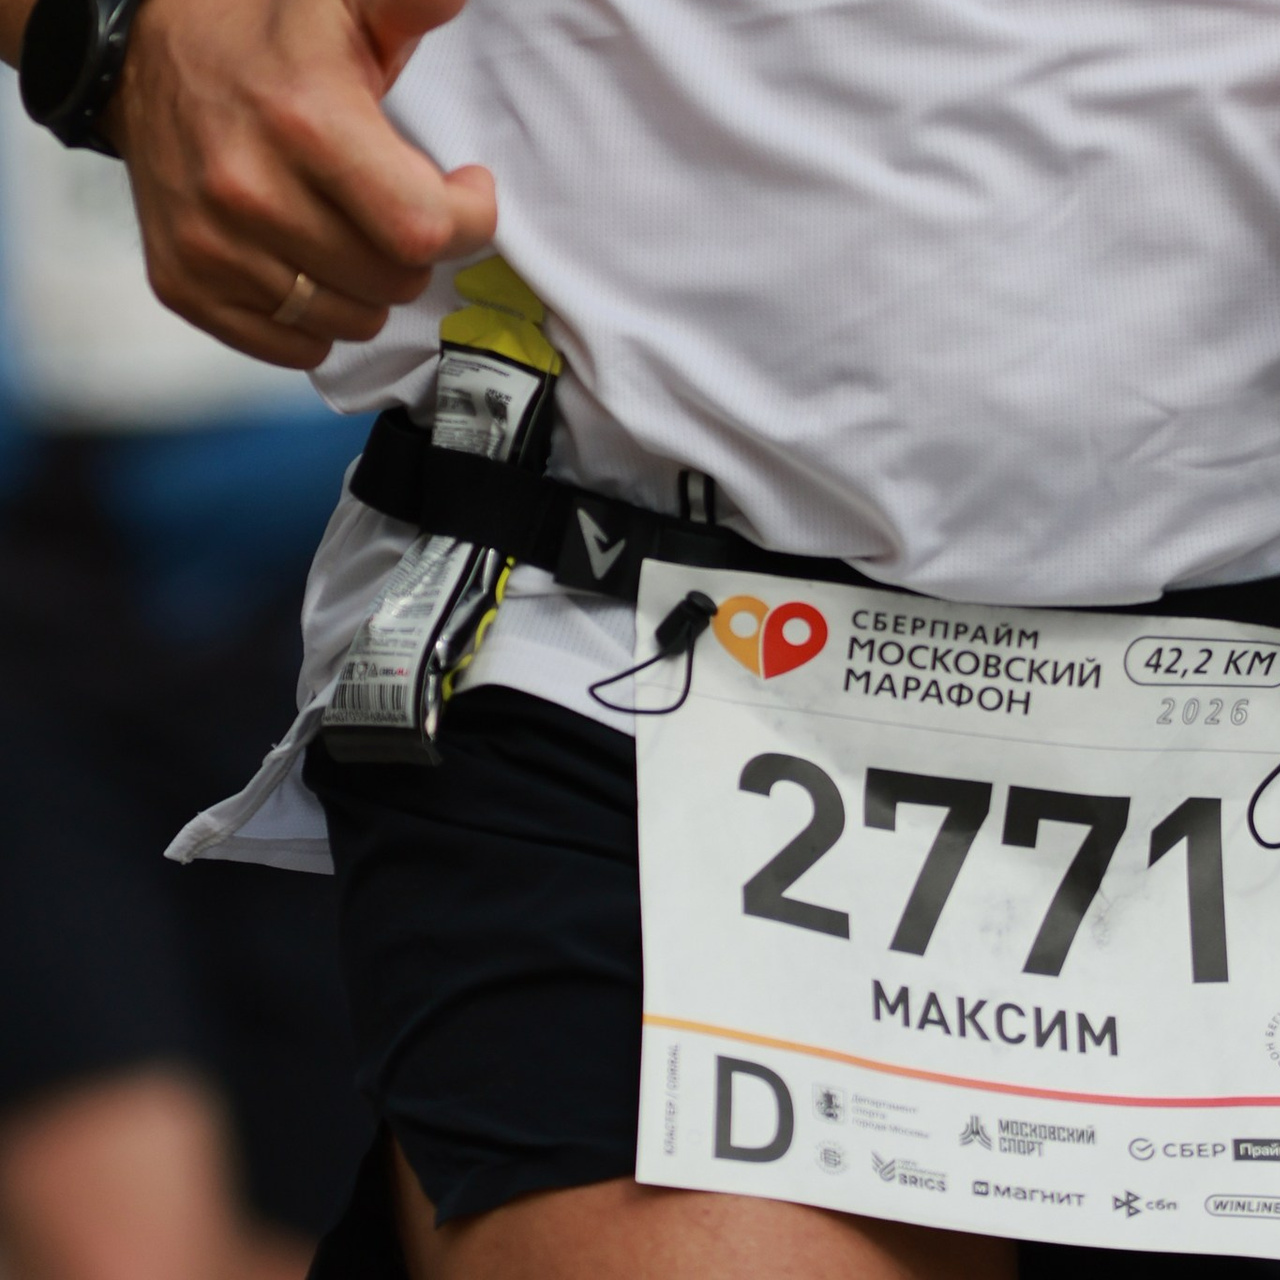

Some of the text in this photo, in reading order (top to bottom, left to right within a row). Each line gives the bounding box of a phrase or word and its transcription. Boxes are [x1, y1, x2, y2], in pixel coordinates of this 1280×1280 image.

[851, 609, 1040, 650] СБЕРПРАЙМ
[847, 635, 1102, 689] МОСКОВСКИЙ
[1144, 647, 1213, 679] 42,2
[843, 667, 1031, 716] МАРАФОН
[1156, 697, 1250, 726] 2026
[738, 752, 1230, 984] 2771
[871, 978, 1120, 1057] МАКСИМ
[714, 1054, 794, 1163] D
[998, 1118, 1096, 1146] МОСКОВСКИЙ
[998, 1137, 1044, 1157] СПОРТ
[1162, 1142, 1227, 1159] СБЕР
[898, 1172, 947, 1192] BRICS
